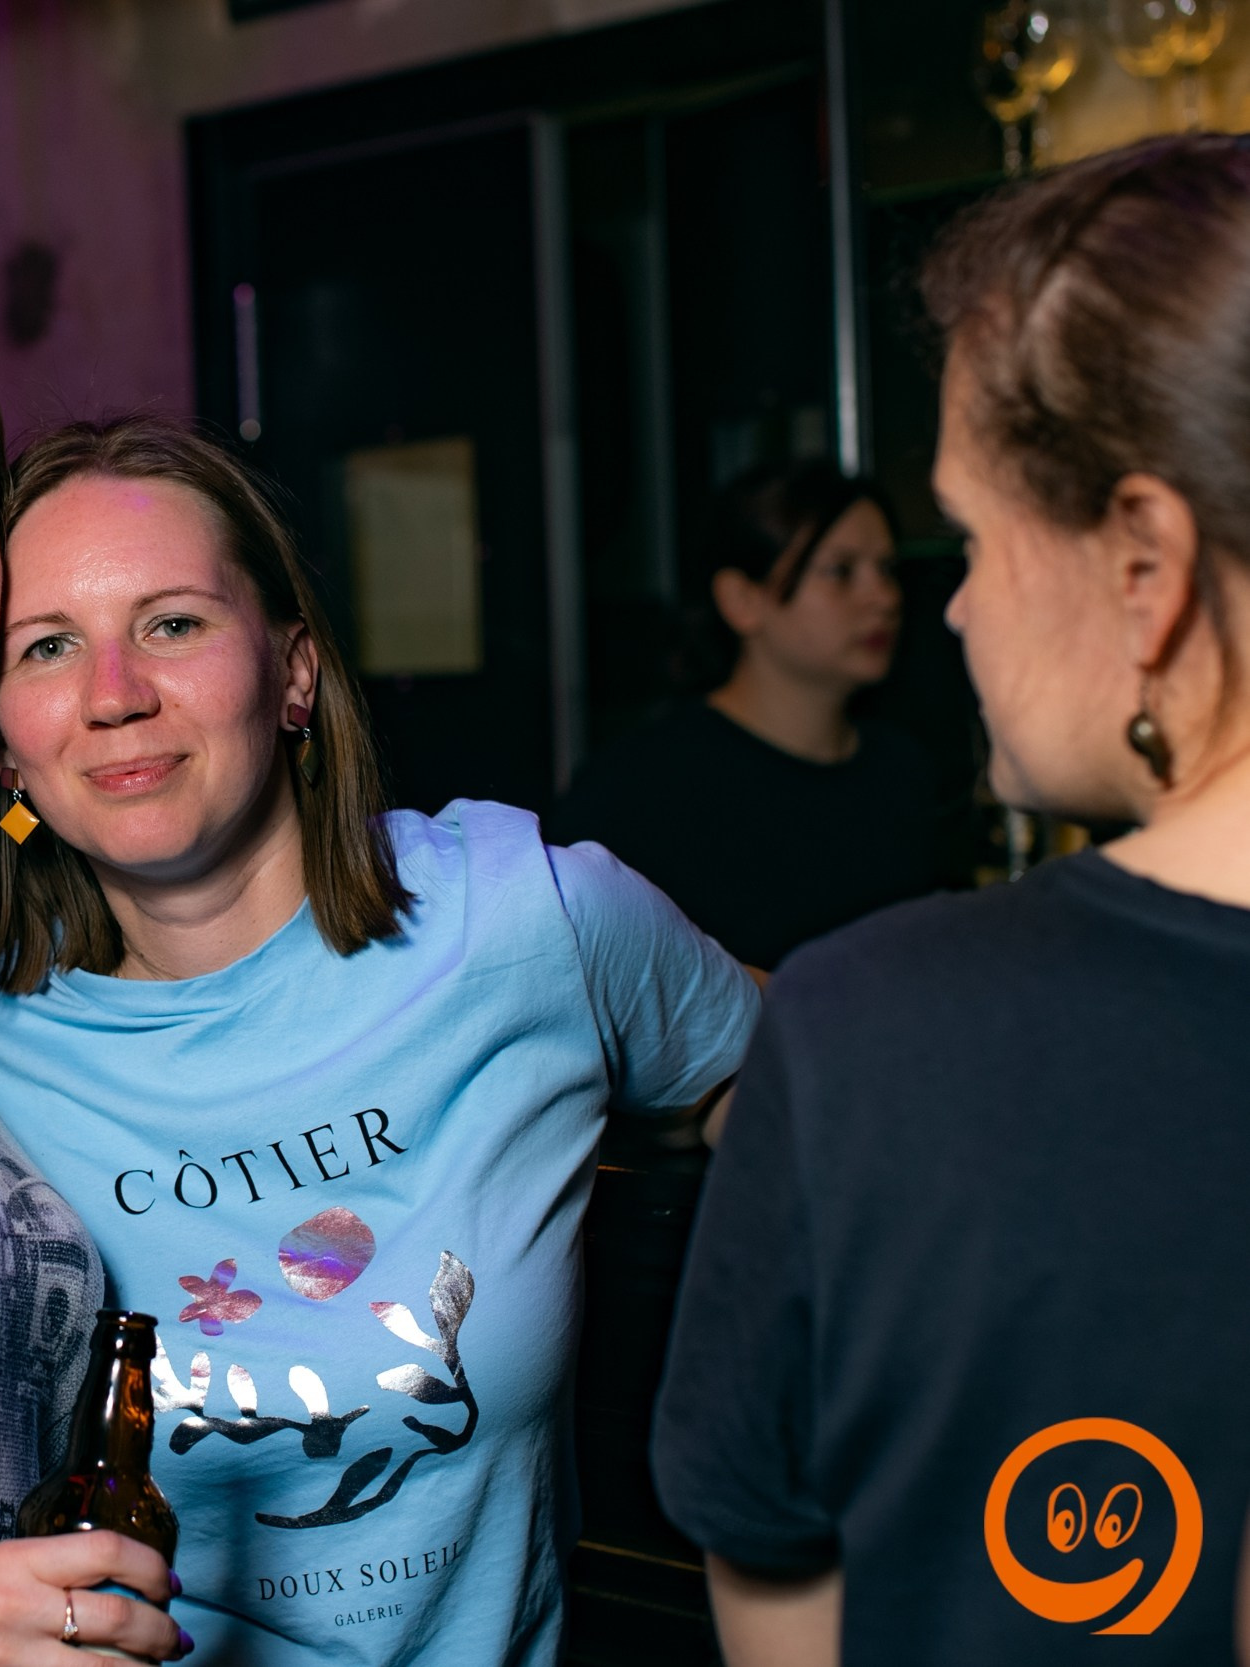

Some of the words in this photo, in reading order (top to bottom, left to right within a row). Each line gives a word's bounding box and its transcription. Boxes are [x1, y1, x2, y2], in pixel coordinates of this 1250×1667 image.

[113, 1107, 410, 1215] CÔTIER
[258, 1568, 345, 1601] DOUX
[359, 1541, 463, 1587] SOLEIL
[334, 1603, 403, 1627] GALERIE
